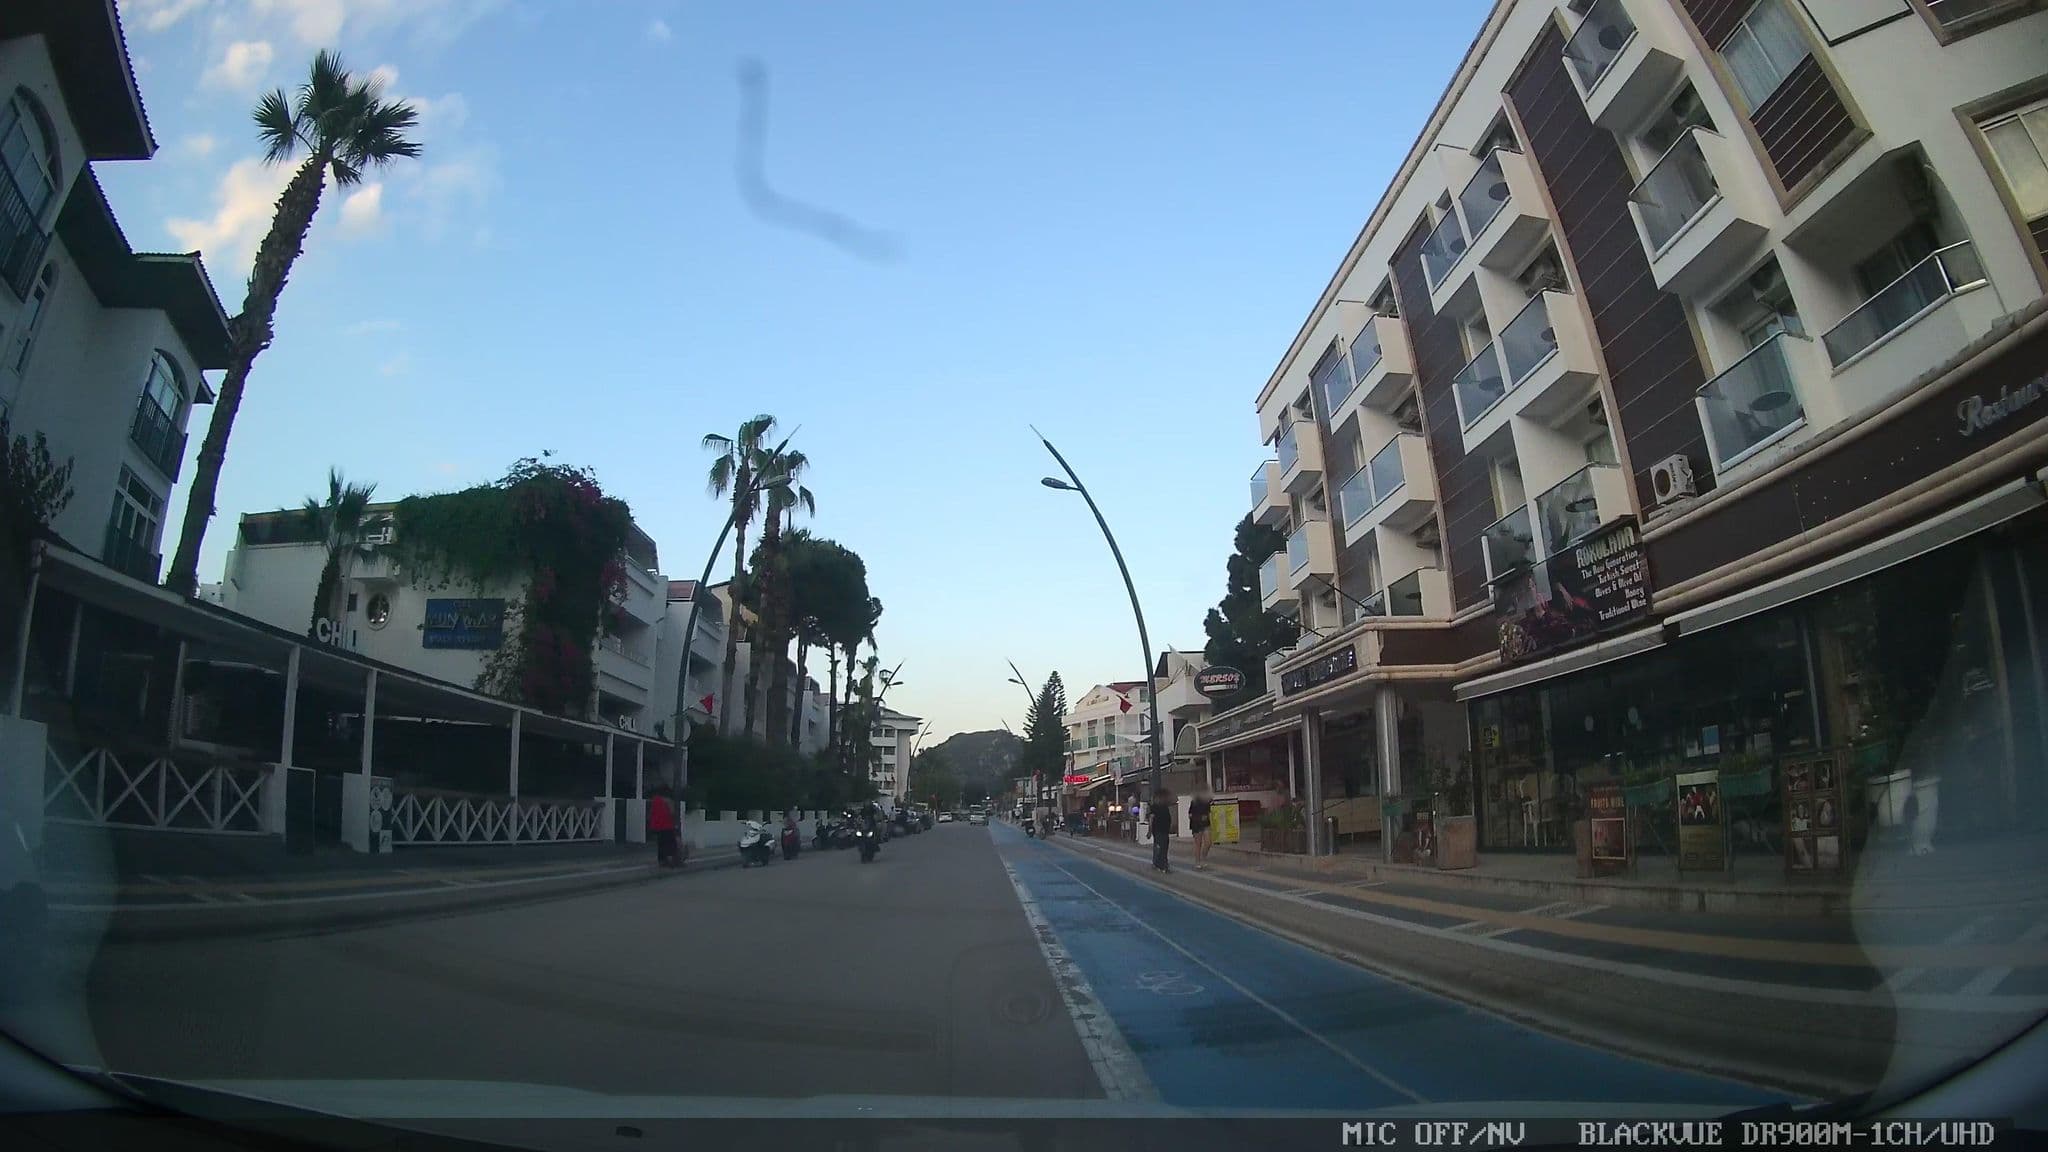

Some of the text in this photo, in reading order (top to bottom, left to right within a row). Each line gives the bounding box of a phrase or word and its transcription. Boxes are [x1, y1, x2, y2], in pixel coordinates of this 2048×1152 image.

[1581, 569, 1593, 579] The
[1605, 550, 1638, 570] Generation
[1598, 568, 1620, 584] Turkish
[1595, 586, 1611, 598] Olives
[1618, 577, 1633, 589] Olive
[1633, 571, 1642, 582] Oil
[1625, 586, 1645, 599] Honey
[1599, 598, 1647, 621] Traditional Wine
